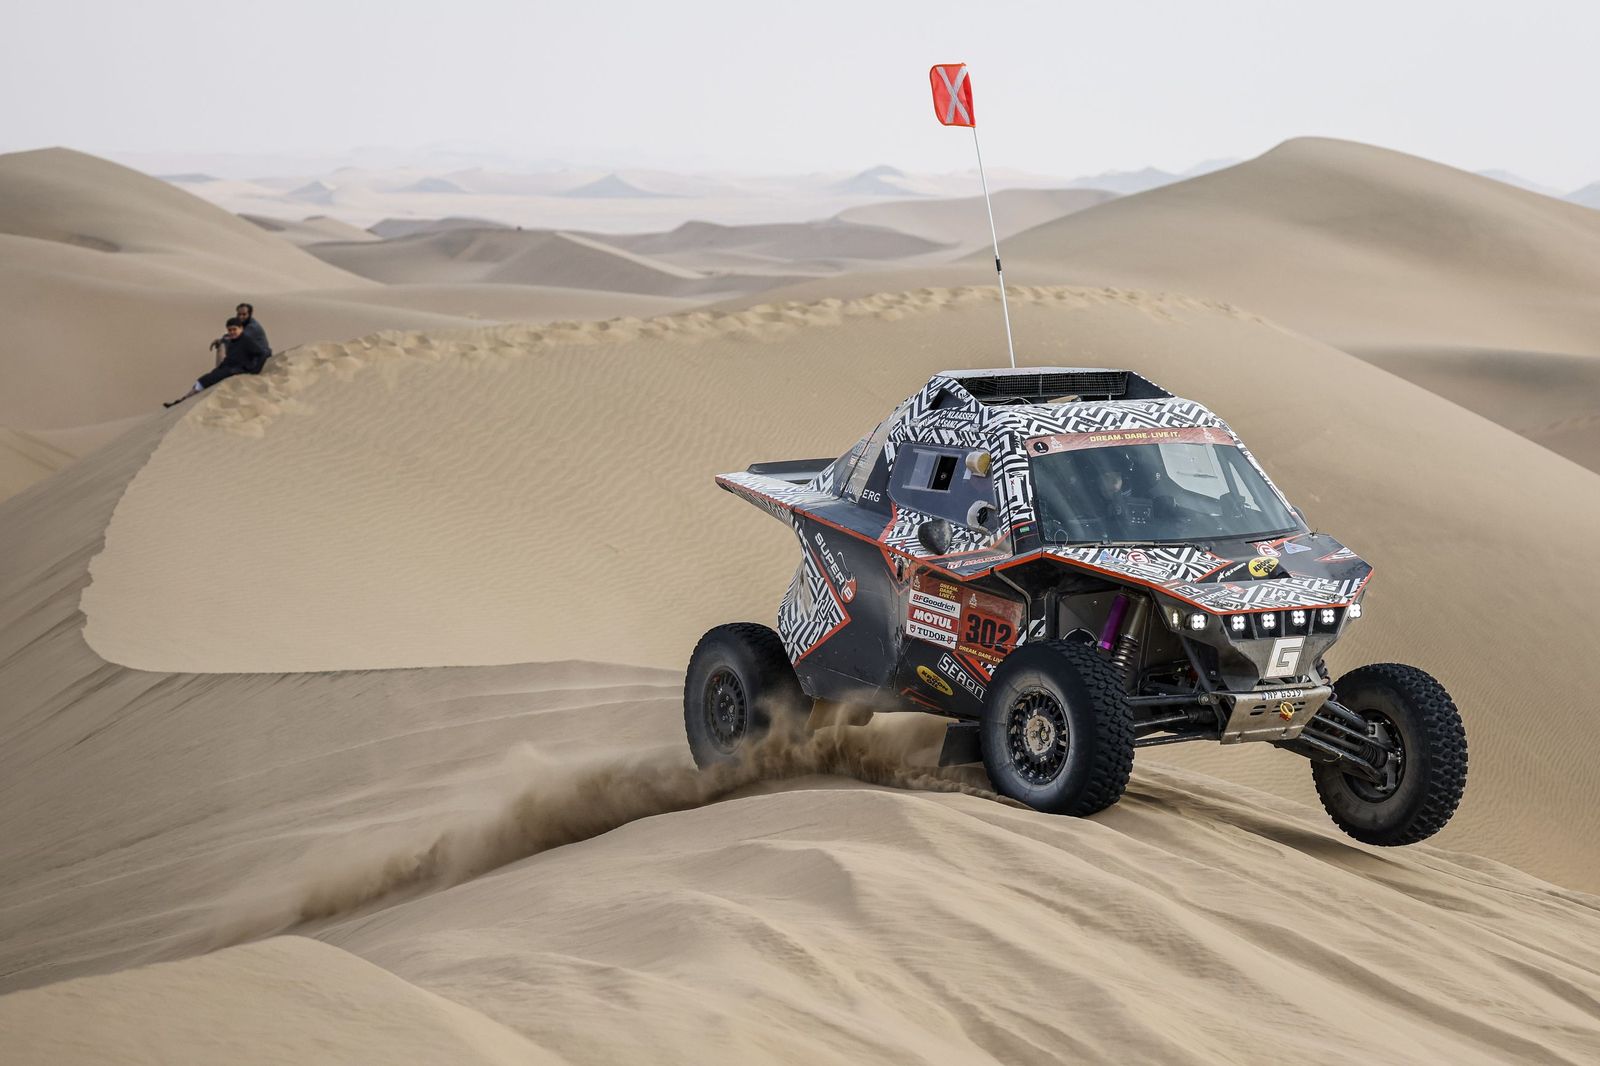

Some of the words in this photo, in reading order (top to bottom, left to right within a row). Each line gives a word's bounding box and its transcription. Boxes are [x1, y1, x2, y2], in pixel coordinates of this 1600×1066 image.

[1089, 434, 1124, 442] DREAM.
[814, 532, 845, 585] SUPER
[843, 586, 854, 600] B
[1263, 563, 1276, 574] OIL
[913, 594, 956, 612] BFGoodrich
[913, 609, 952, 629] MOTUL
[917, 627, 946, 641] TUDOR
[965, 614, 1012, 654] 302
[959, 645, 977, 656] DREAM.
[977, 651, 993, 661] DARE.
